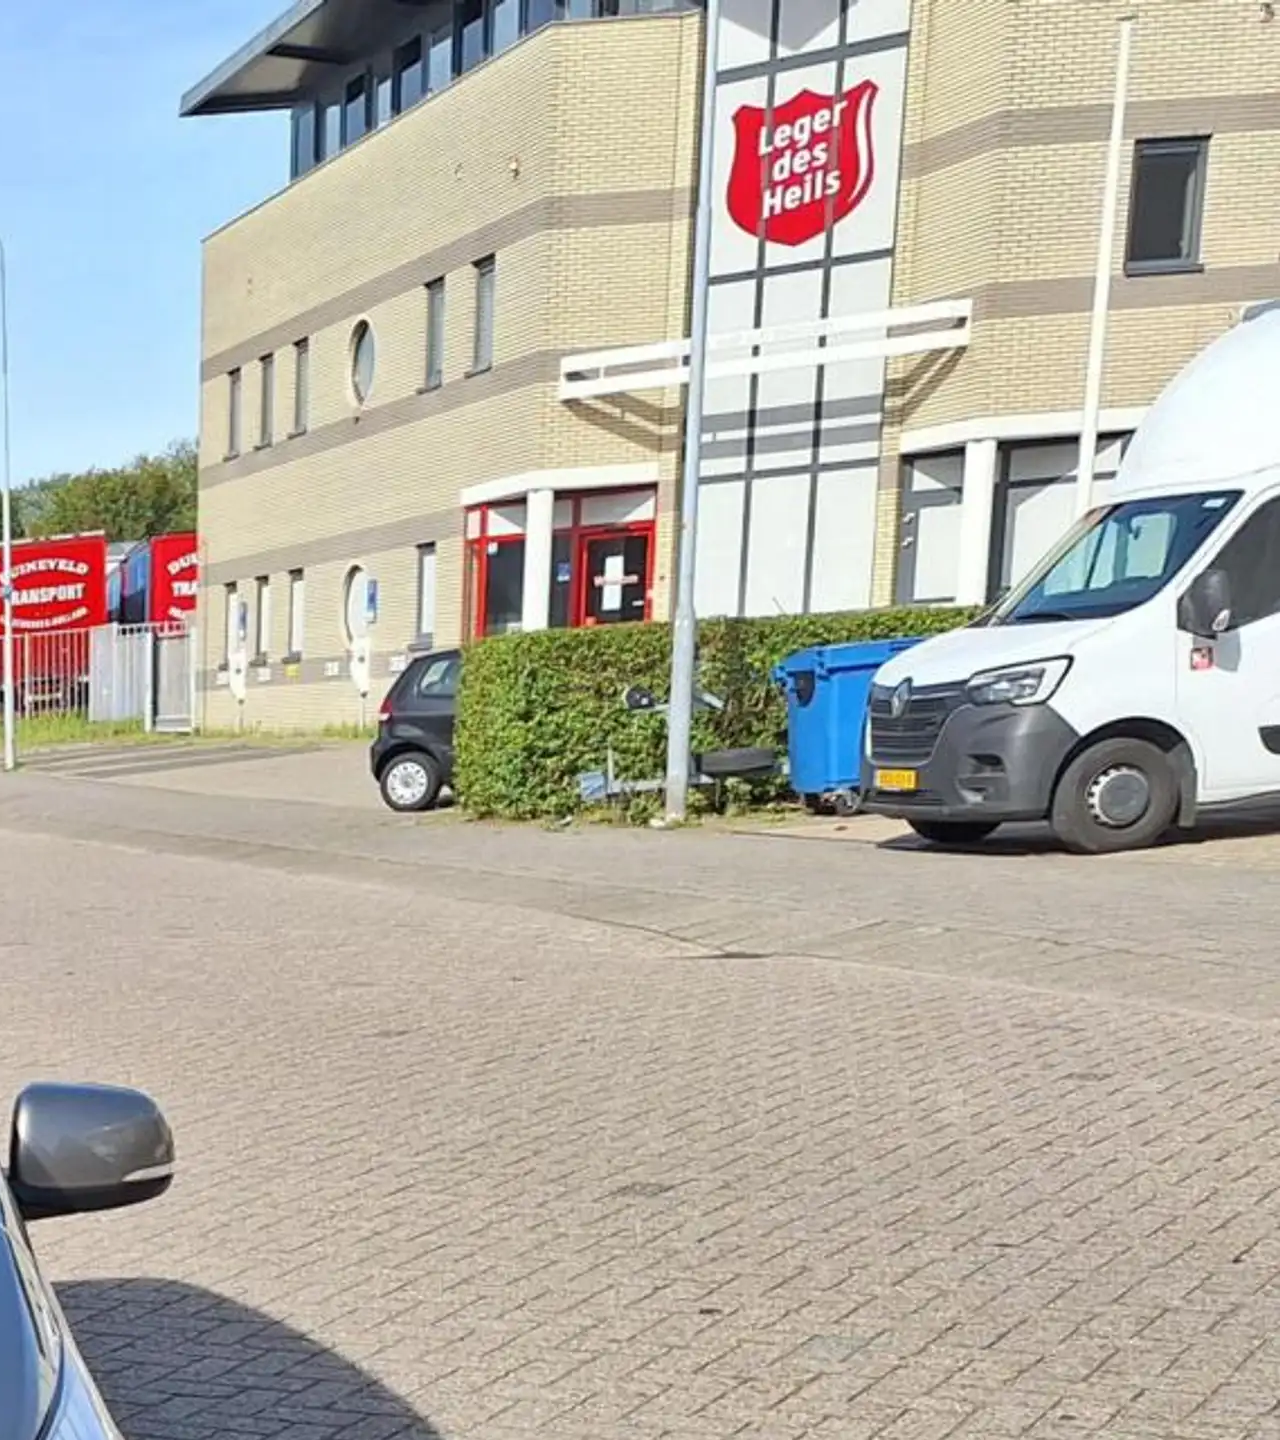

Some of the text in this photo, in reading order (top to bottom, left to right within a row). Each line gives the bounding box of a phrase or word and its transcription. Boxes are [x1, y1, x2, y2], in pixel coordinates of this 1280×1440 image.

[758, 99, 848, 157] Leger
[771, 141, 829, 182] des
[761, 168, 841, 220] Heils
[0, 582, 86, 606] RANSPORT
